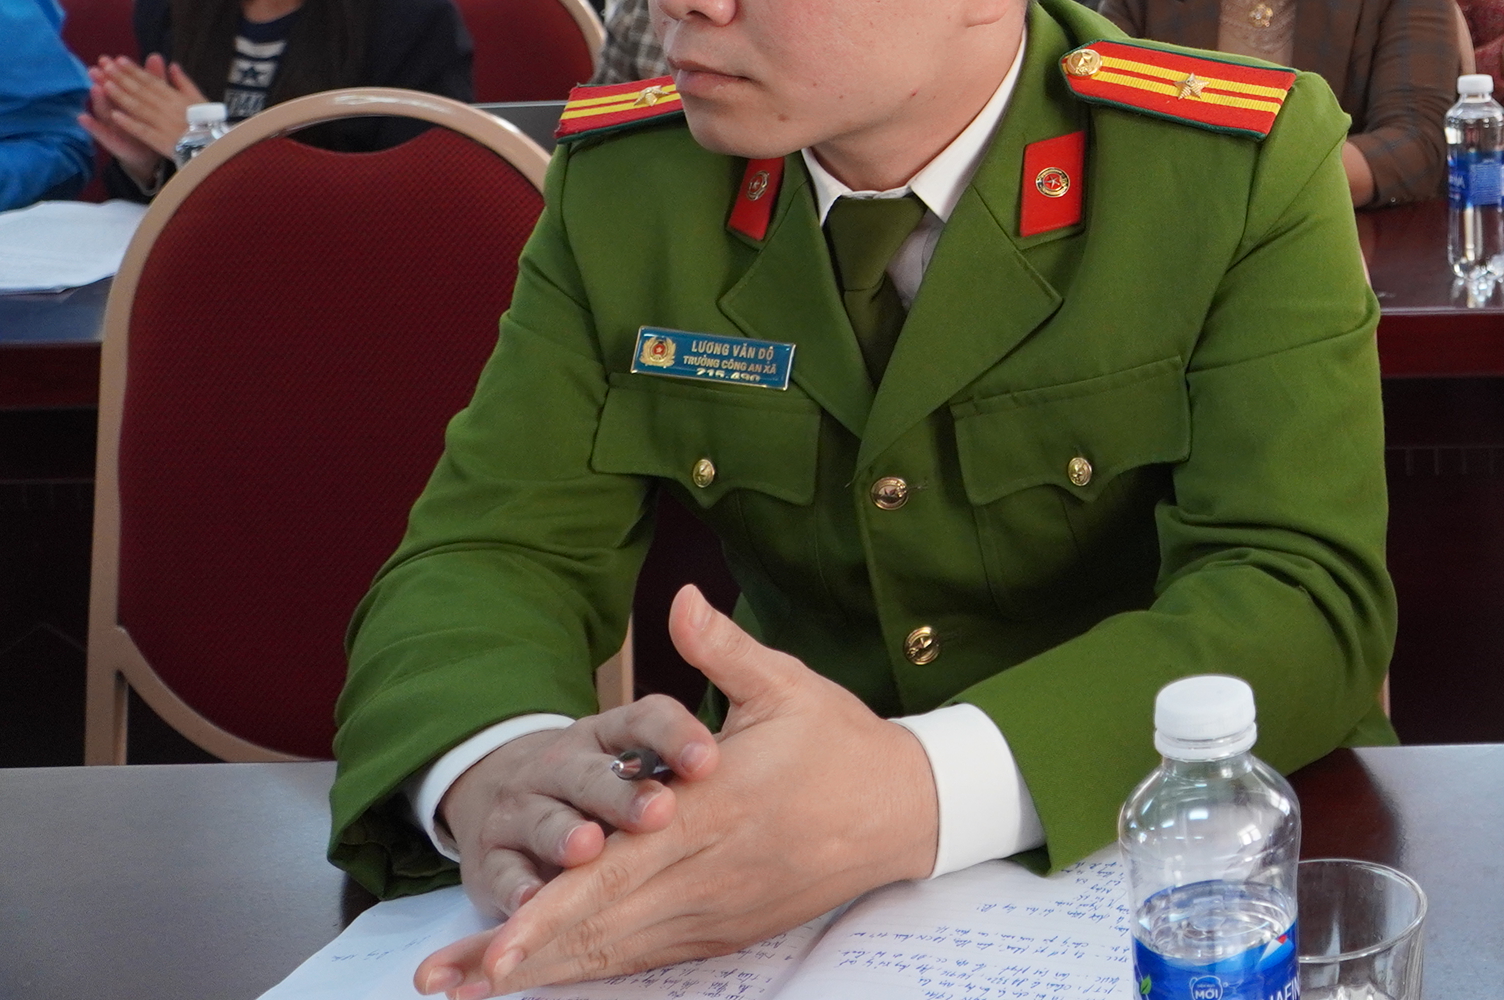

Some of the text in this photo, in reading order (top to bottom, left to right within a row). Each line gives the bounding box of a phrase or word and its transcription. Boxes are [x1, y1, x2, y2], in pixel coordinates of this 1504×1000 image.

[732, 343, 756, 359] VĂN
[721, 359, 747, 371] CÔNG
[747, 363, 762, 373] AN
[763, 364, 777, 375] XÃ
